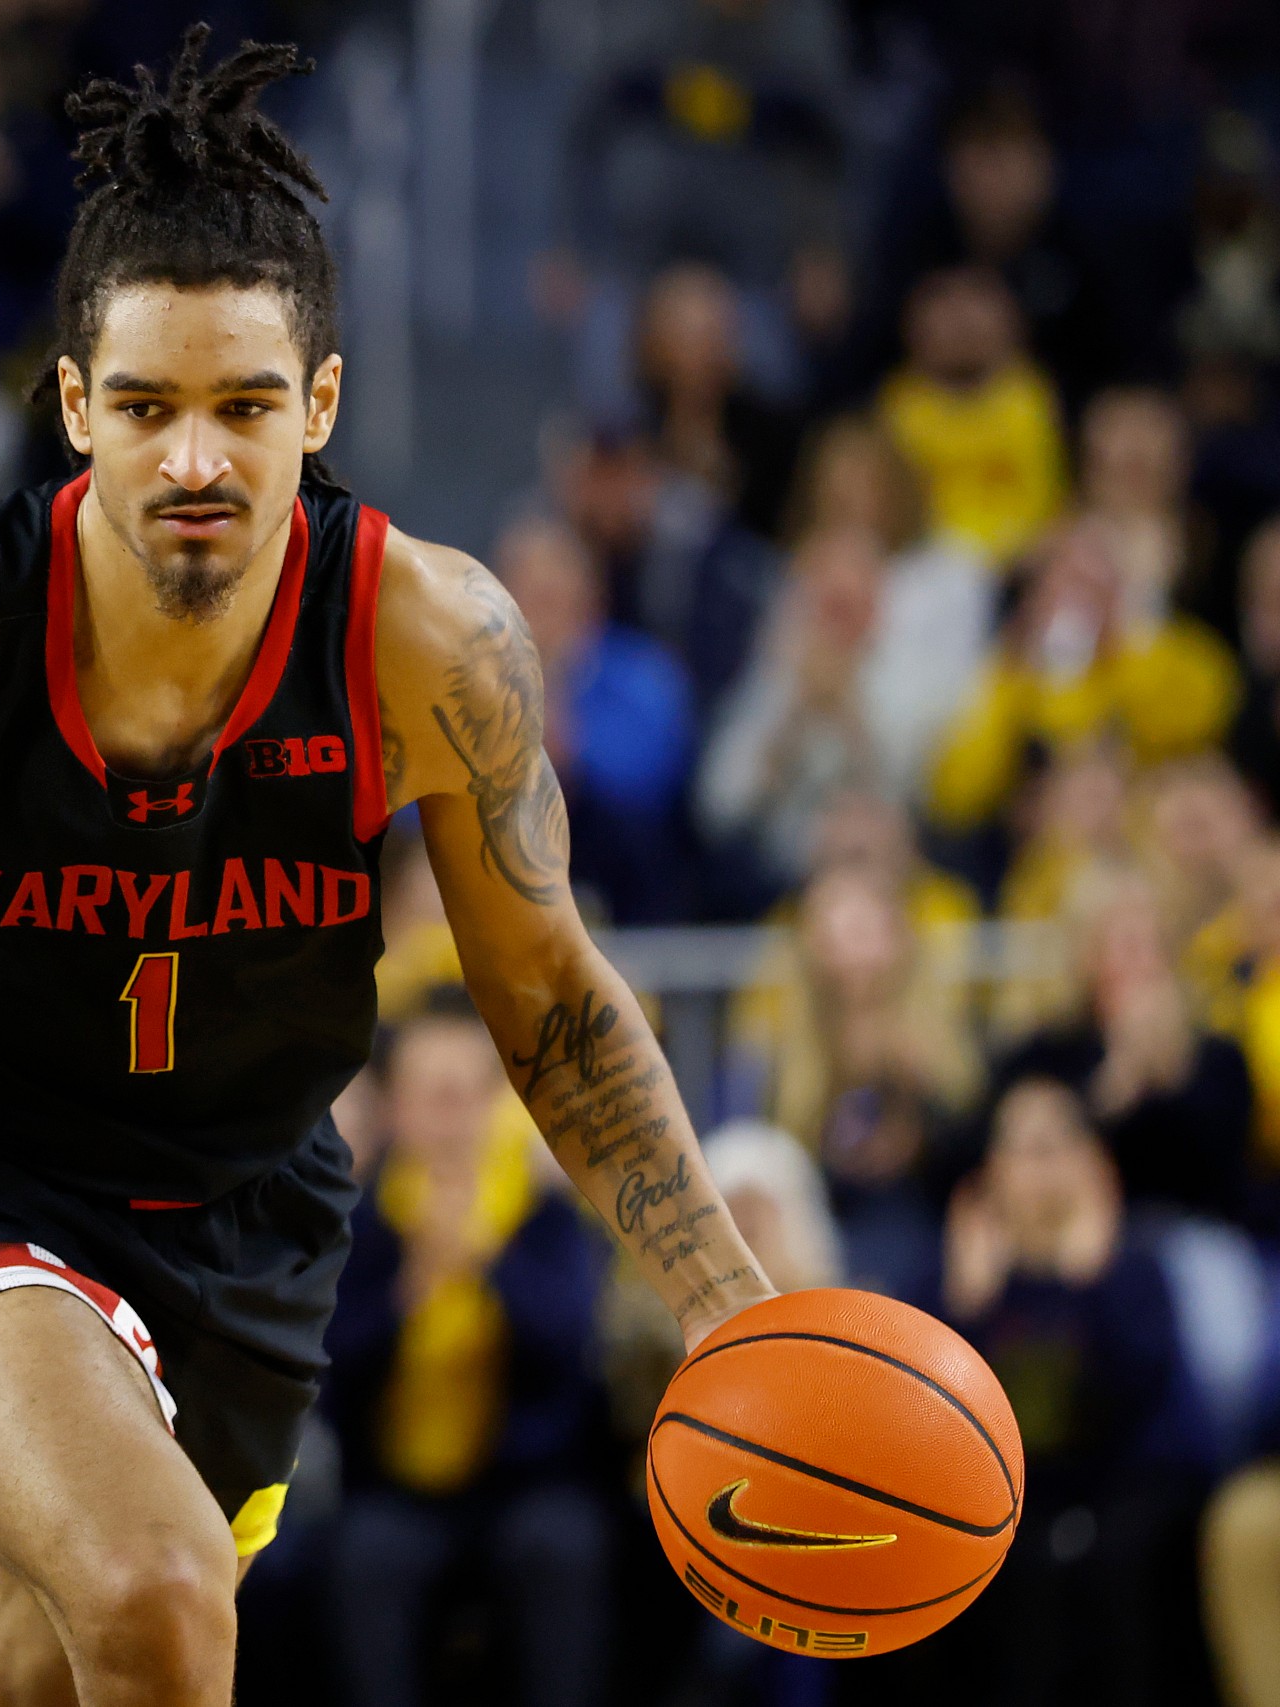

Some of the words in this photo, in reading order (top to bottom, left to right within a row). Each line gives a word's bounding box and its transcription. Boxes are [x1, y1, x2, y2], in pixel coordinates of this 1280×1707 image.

[119, 952, 179, 1074] 1
[513, 990, 618, 1103] Life
[616, 1153, 690, 1234] God
[685, 1560, 869, 1652] ELITE
